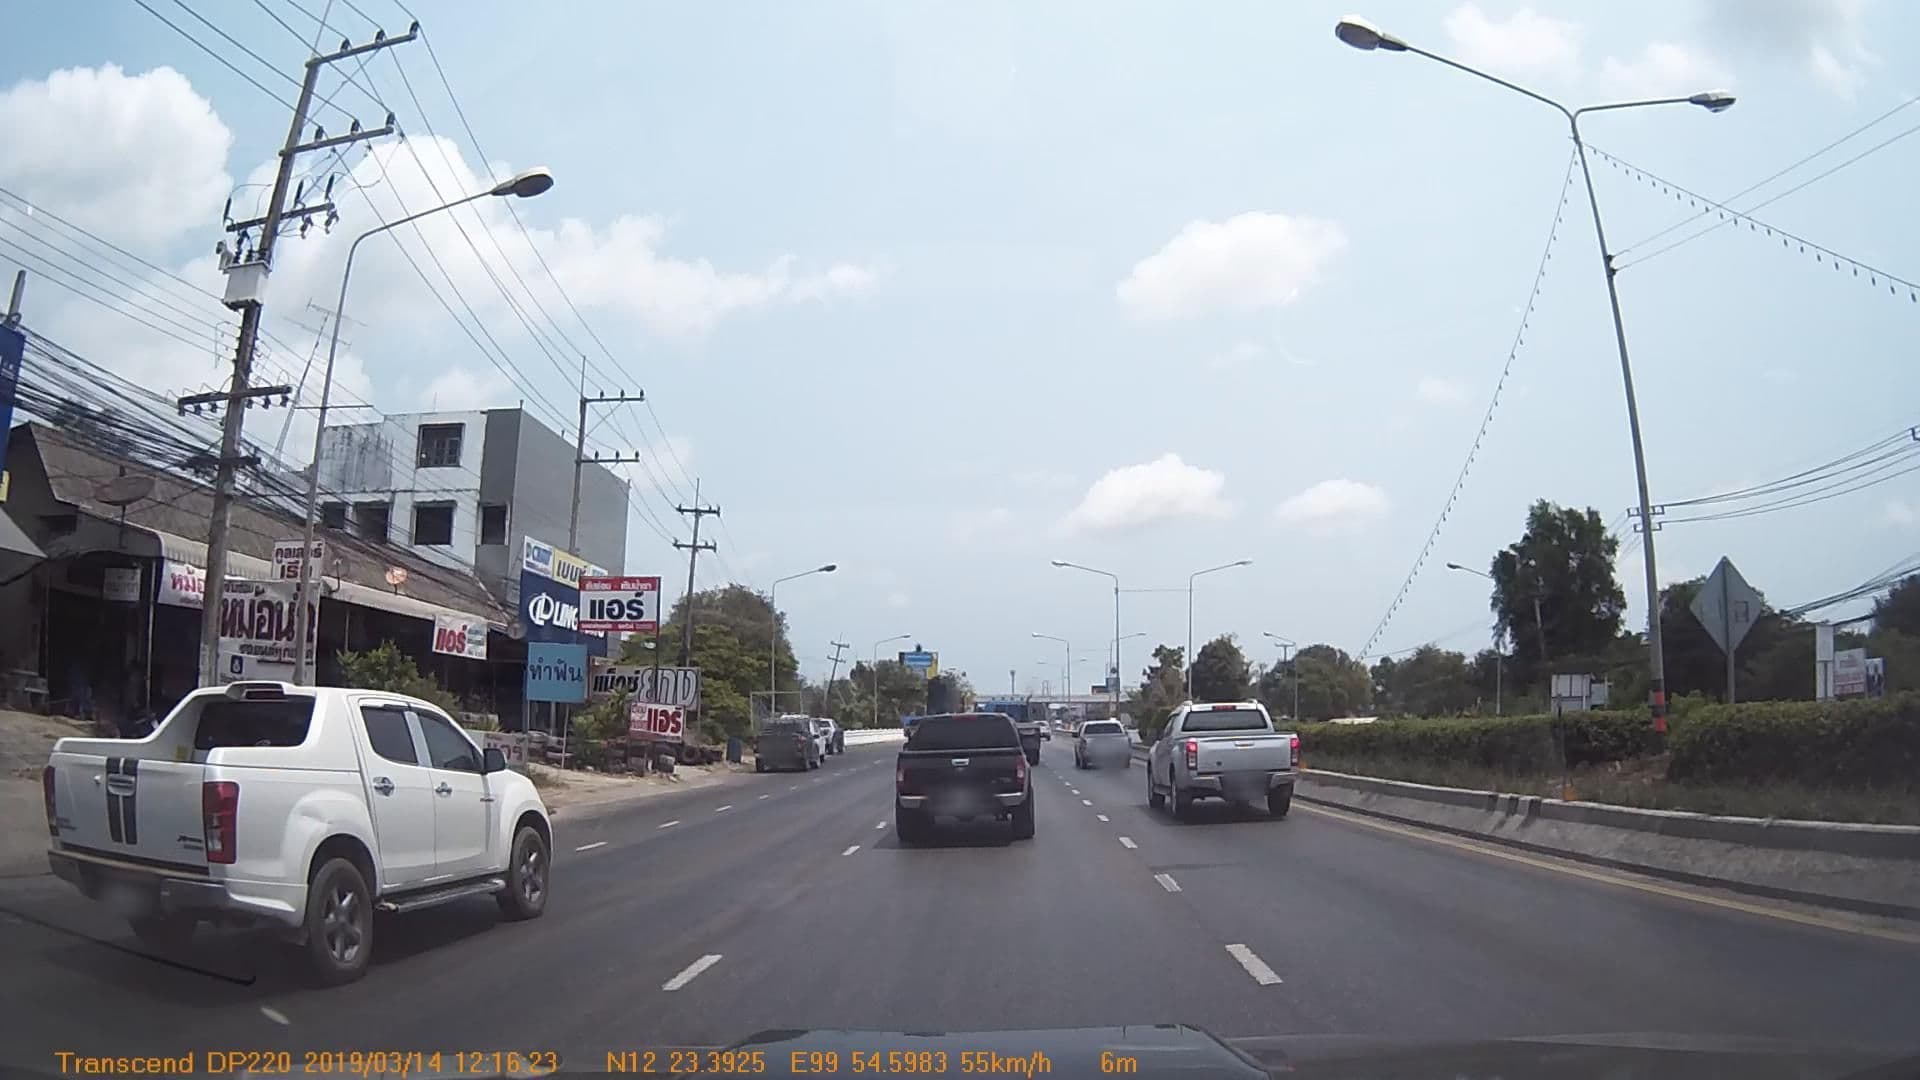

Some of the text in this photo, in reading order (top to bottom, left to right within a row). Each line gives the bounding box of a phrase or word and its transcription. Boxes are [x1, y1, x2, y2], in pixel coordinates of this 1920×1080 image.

[589, 591, 645, 620] แอร์
[435, 624, 468, 654] แอร์
[529, 656, 584, 682] ทำฟัน
